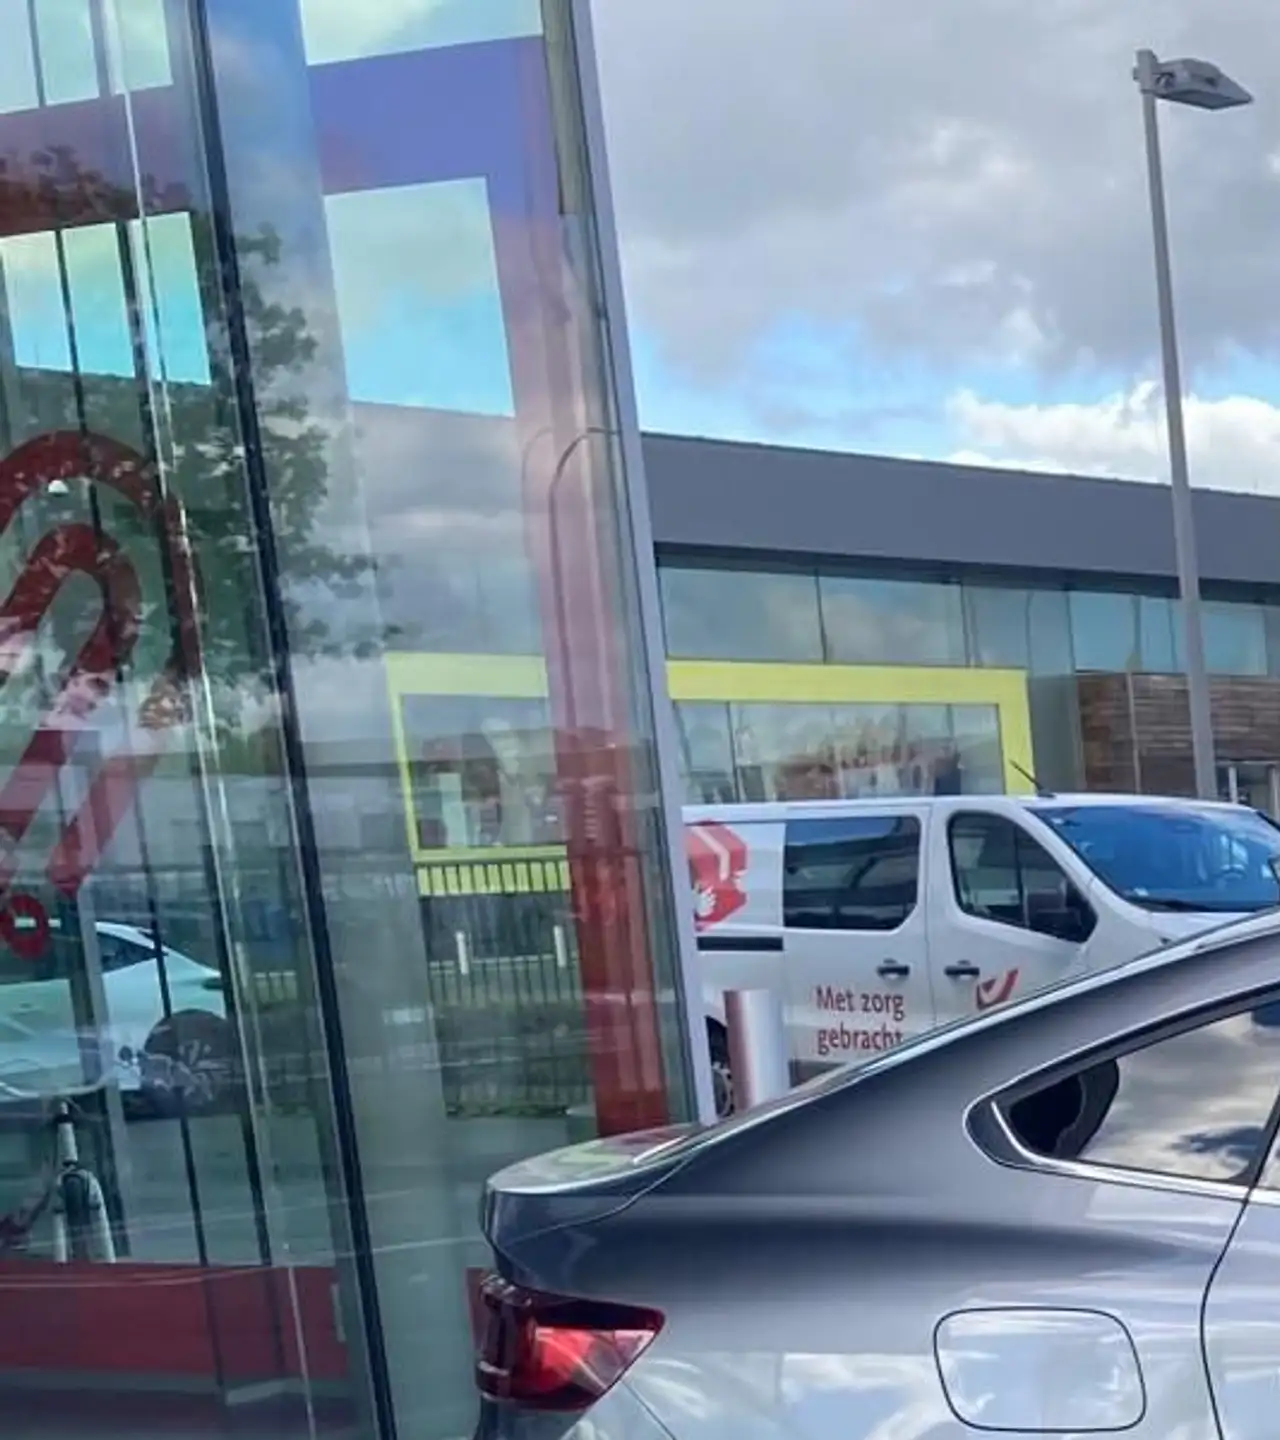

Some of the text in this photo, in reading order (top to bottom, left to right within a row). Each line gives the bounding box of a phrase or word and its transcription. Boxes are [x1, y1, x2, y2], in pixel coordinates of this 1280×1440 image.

[816, 985, 905, 1022] Met zorg
[817, 1022, 904, 1056] gebracht
